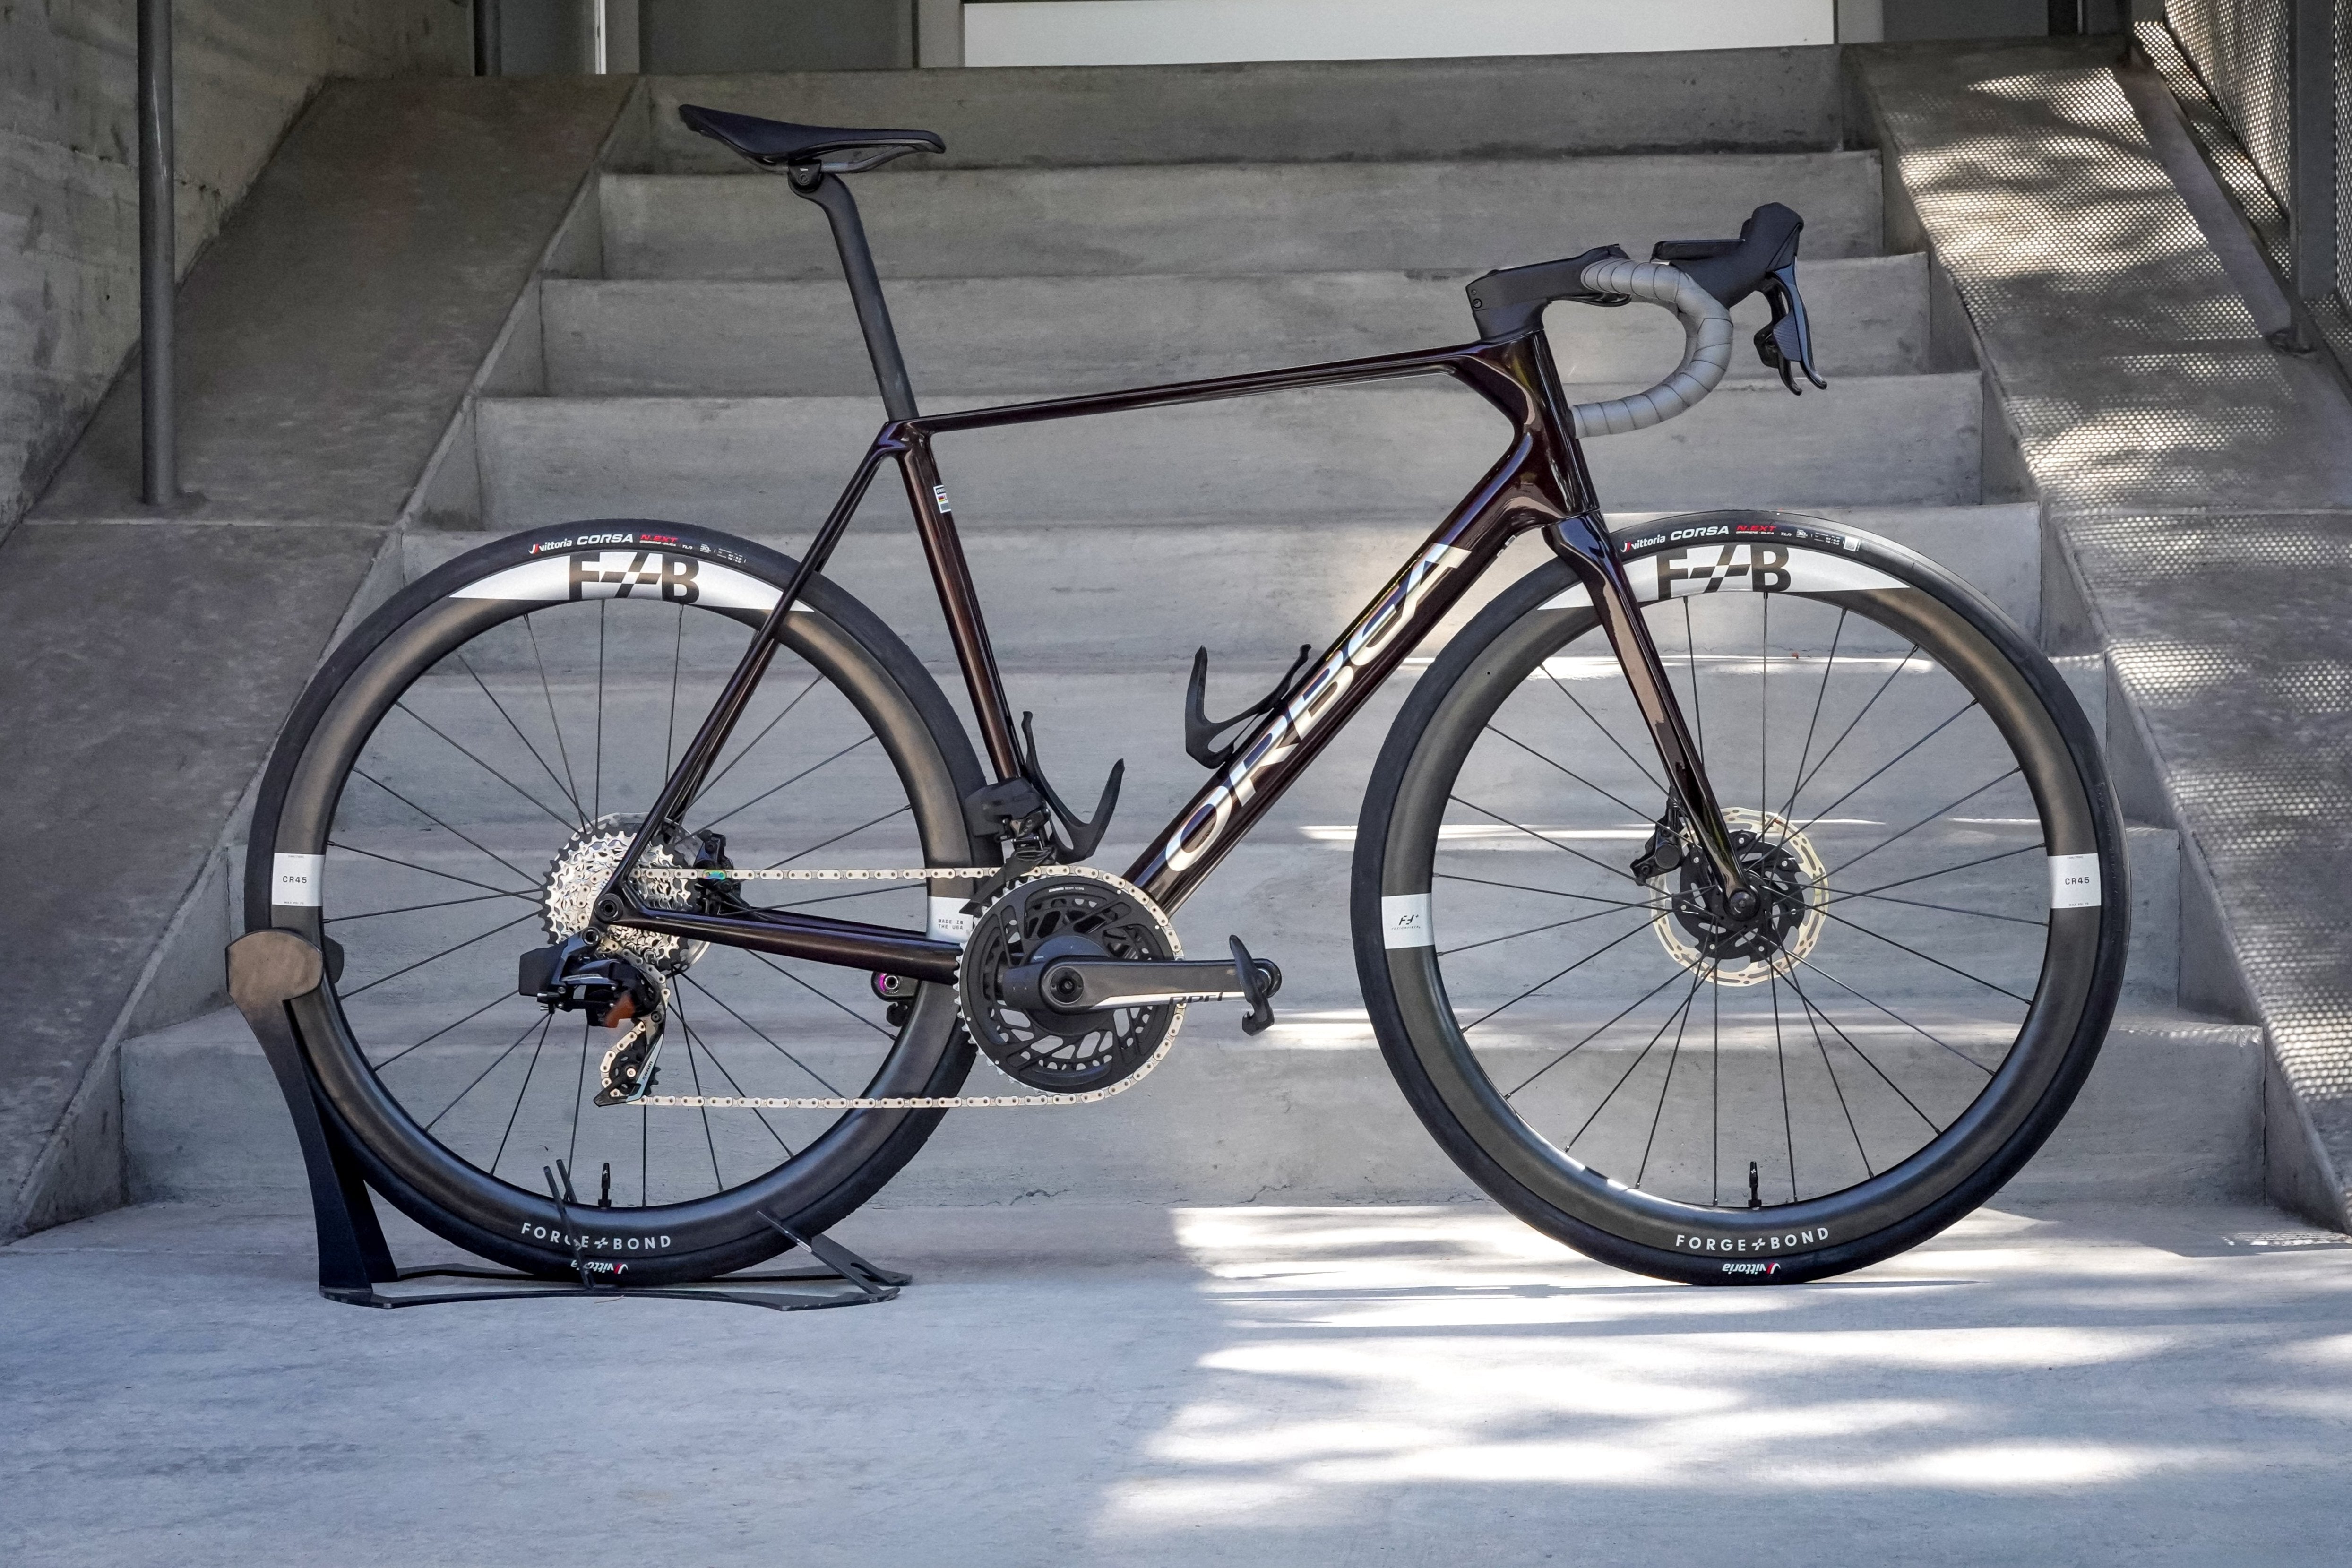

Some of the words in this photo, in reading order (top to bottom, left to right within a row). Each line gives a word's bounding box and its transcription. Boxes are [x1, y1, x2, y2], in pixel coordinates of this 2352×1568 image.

[539, 538, 573, 552] vittoria
[577, 534, 633, 545] CORSA
[1631, 534, 1666, 550] vittoria
[1671, 526, 1729, 541] CORSA
[1165, 543, 1472, 871] ORBEA
[283, 876, 307, 884] CR45
[2065, 877, 2090, 885] CR45
[1722, 1263, 1766, 1275] vittoria
